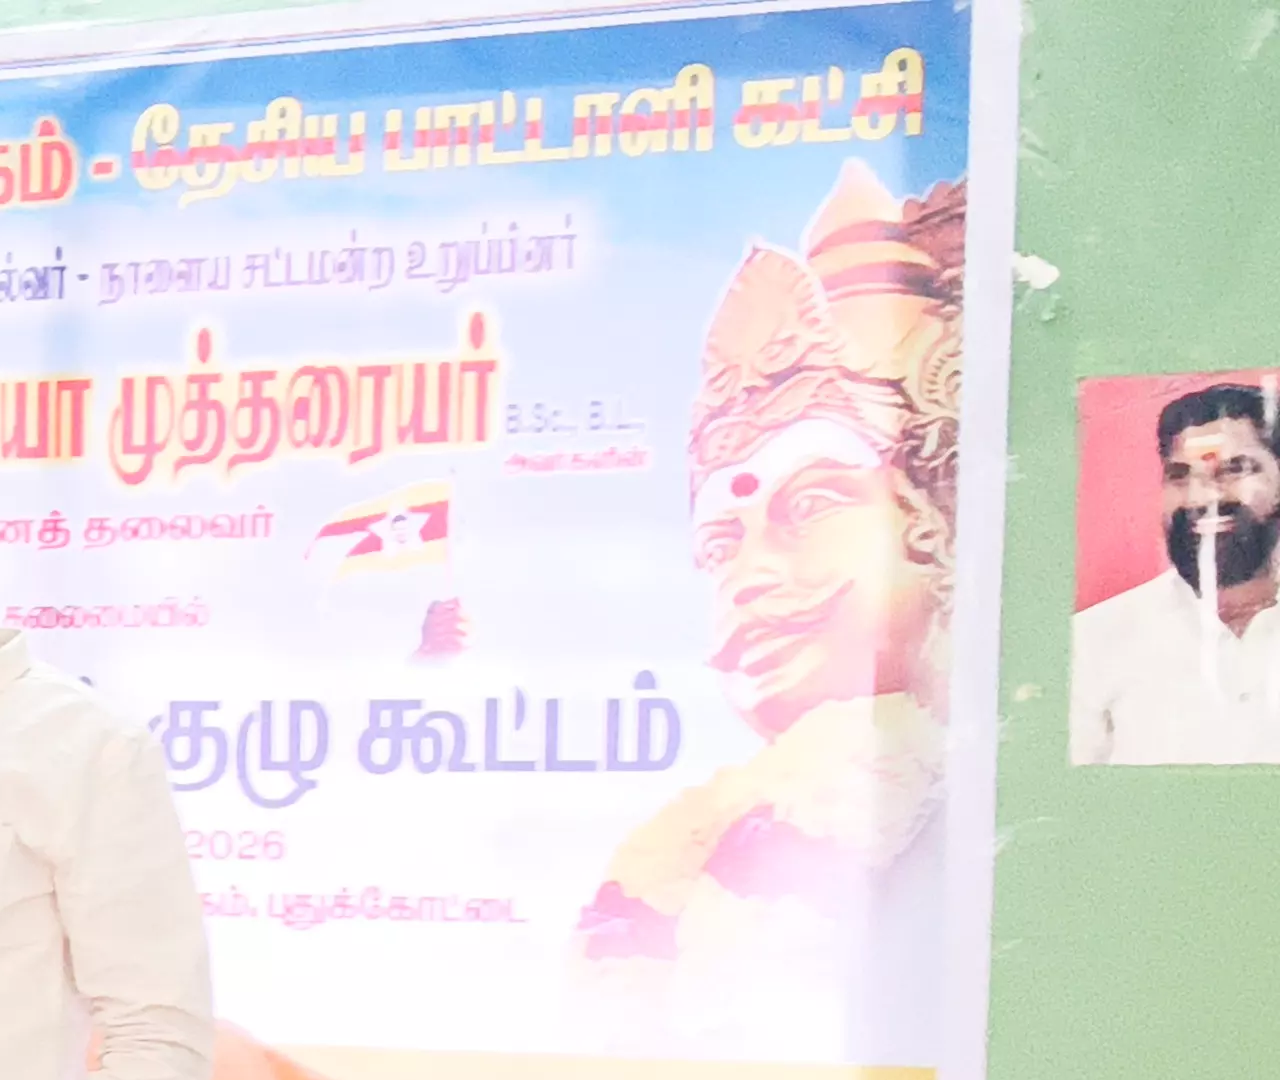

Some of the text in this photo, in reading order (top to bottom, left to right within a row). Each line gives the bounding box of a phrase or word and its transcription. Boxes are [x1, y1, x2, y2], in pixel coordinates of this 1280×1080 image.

[131, 97, 366, 211] தேசிய
[383, 63, 713, 173] பாட்டாளி
[732, 46, 922, 148] கட்சி
[109, 311, 497, 486] முத்தரையர்
[82, 504, 274, 549] தலைவர்
[357, 669, 682, 776] கூட்டம்
